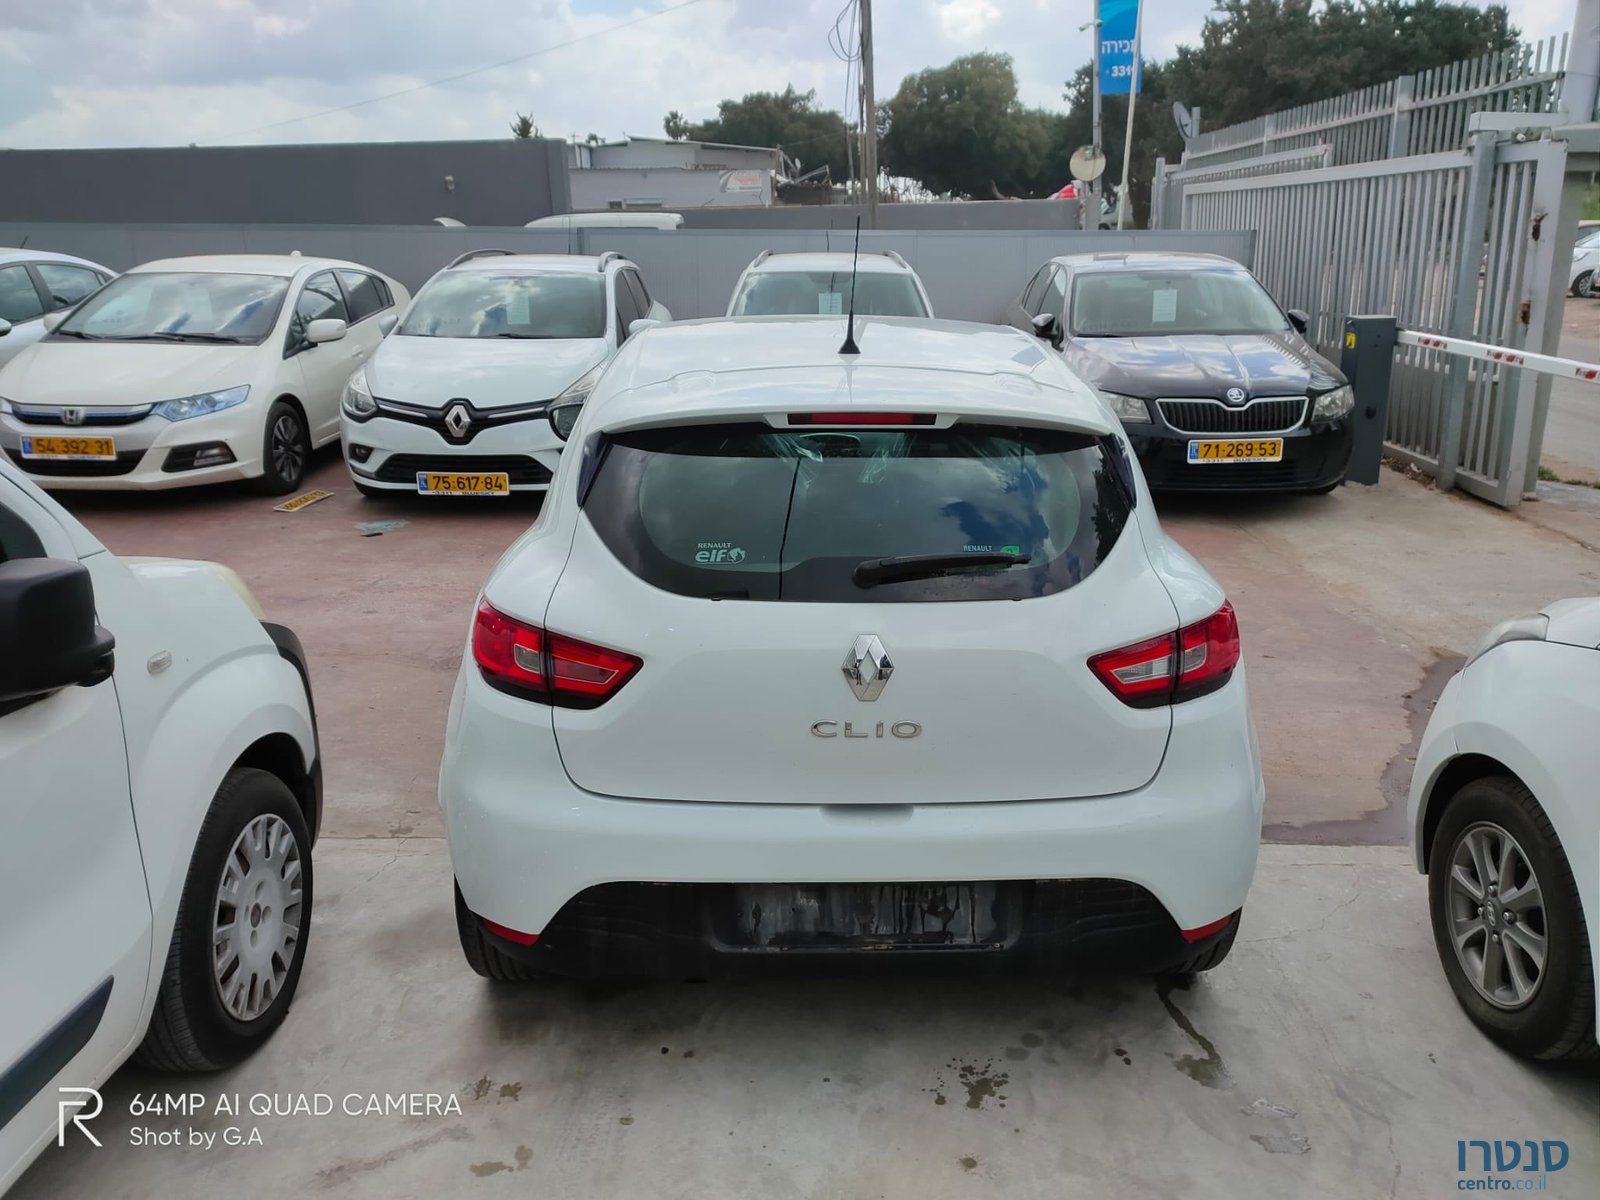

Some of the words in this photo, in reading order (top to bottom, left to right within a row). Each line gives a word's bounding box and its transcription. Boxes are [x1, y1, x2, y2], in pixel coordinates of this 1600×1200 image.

[1101, 40, 1134, 54] כירה
[695, 549, 727, 563] elf
[810, 719, 923, 739] CLIO
